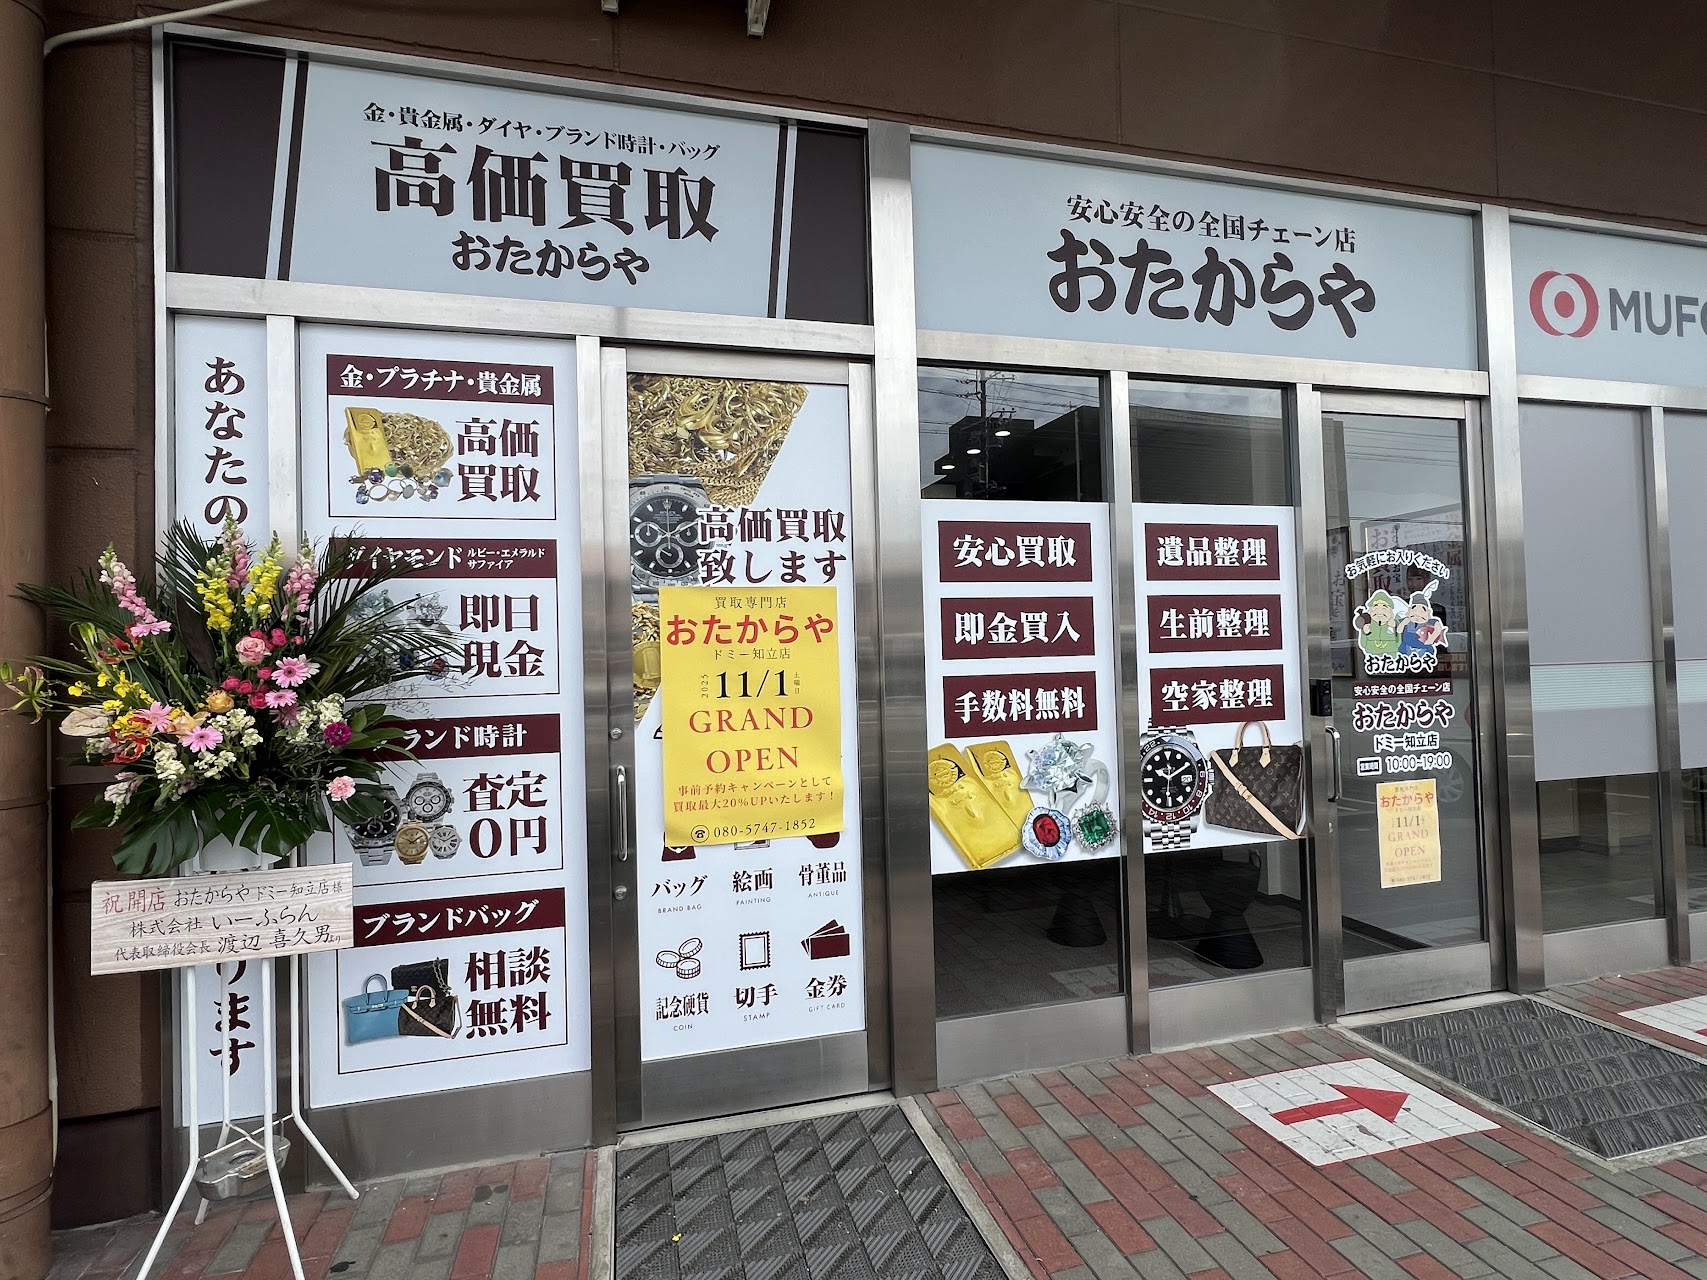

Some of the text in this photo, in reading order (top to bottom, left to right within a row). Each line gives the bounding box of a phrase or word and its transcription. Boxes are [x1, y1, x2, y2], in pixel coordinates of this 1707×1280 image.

[371, 136, 720, 243] 高価買取
[1066, 194, 1354, 254] 安心安全の全国チェーン店
[451, 231, 649, 285] おたからや
[1046, 228, 1376, 338] おたからや
[340, 363, 542, 397] 金・プラチナ・貴金属
[456, 417, 540, 457] 高価
[457, 463, 542, 502] 買取
[699, 507, 847, 543] 高価買取
[466, 547, 546, 559] ルビー・エメラルド
[467, 560, 514, 570] サファイア
[953, 534, 1077, 568] 安心買取
[1157, 535, 1269, 567] 遺品整理
[1346, 550, 1450, 578] お気軽にお入りください
[700, 549, 847, 584] 致します
[460, 594, 540, 632] 即日
[714, 596, 788, 609] 買取専門店
[666, 613, 834, 645] おたからや
[955, 611, 1081, 645] 即金買入
[1160, 607, 1271, 639] 生前整理
[460, 640, 545, 678] 現金
[714, 648, 791, 661] ドミー知立店
[1366, 653, 1437, 673] おたからや
[701, 670, 789, 699] 2025 11/1
[1161, 677, 1274, 712] 空家整理
[1353, 682, 1451, 696] 安心安全の全国チェーン店
[954, 686, 1086, 724] 手数料無料
[1354, 700, 1455, 730] おたからや
[688, 706, 814, 734] GRAND
[372, 723, 528, 753] ランド時計
[1375, 733, 1438, 751] ドミー知立店
[706, 746, 798, 774] OPEN
[463, 770, 548, 812] 査定
[678, 777, 832, 797] 事前予約キャンペーンとして
[1380, 791, 1434, 808] おたからや
[714, 818, 816, 838] 080-5747-1852
[1387, 829, 1429, 842] GRAND
[1394, 846, 1425, 858] OPEN
[651, 875, 708, 897] バッグ
[732, 867, 774, 893] 絵画
[798, 861, 847, 886] 骨董品
[174, 884, 250, 907] おたからや
[736, 896, 771, 905] PAINTING
[808, 889, 839, 898] ANTIQUE
[132, 903, 319, 938] 株式会社 いーふらん
[363, 899, 541, 939] ブランドバッグ
[658, 903, 702, 914] BRAND BAG
[115, 940, 210, 961] 代表取締役会長
[218, 934, 262, 954] 渡辺
[464, 945, 551, 992] 相談
[732, 983, 778, 1010] 切手
[805, 974, 847, 1000] 金券
[465, 992, 552, 1039] 無料
[656, 992, 709, 1020] 記念硬貨
[743, 1012, 771, 1022] STAMP
[808, 1002, 846, 1013] GIFT CARD
[673, 1023, 693, 1032] COIN
